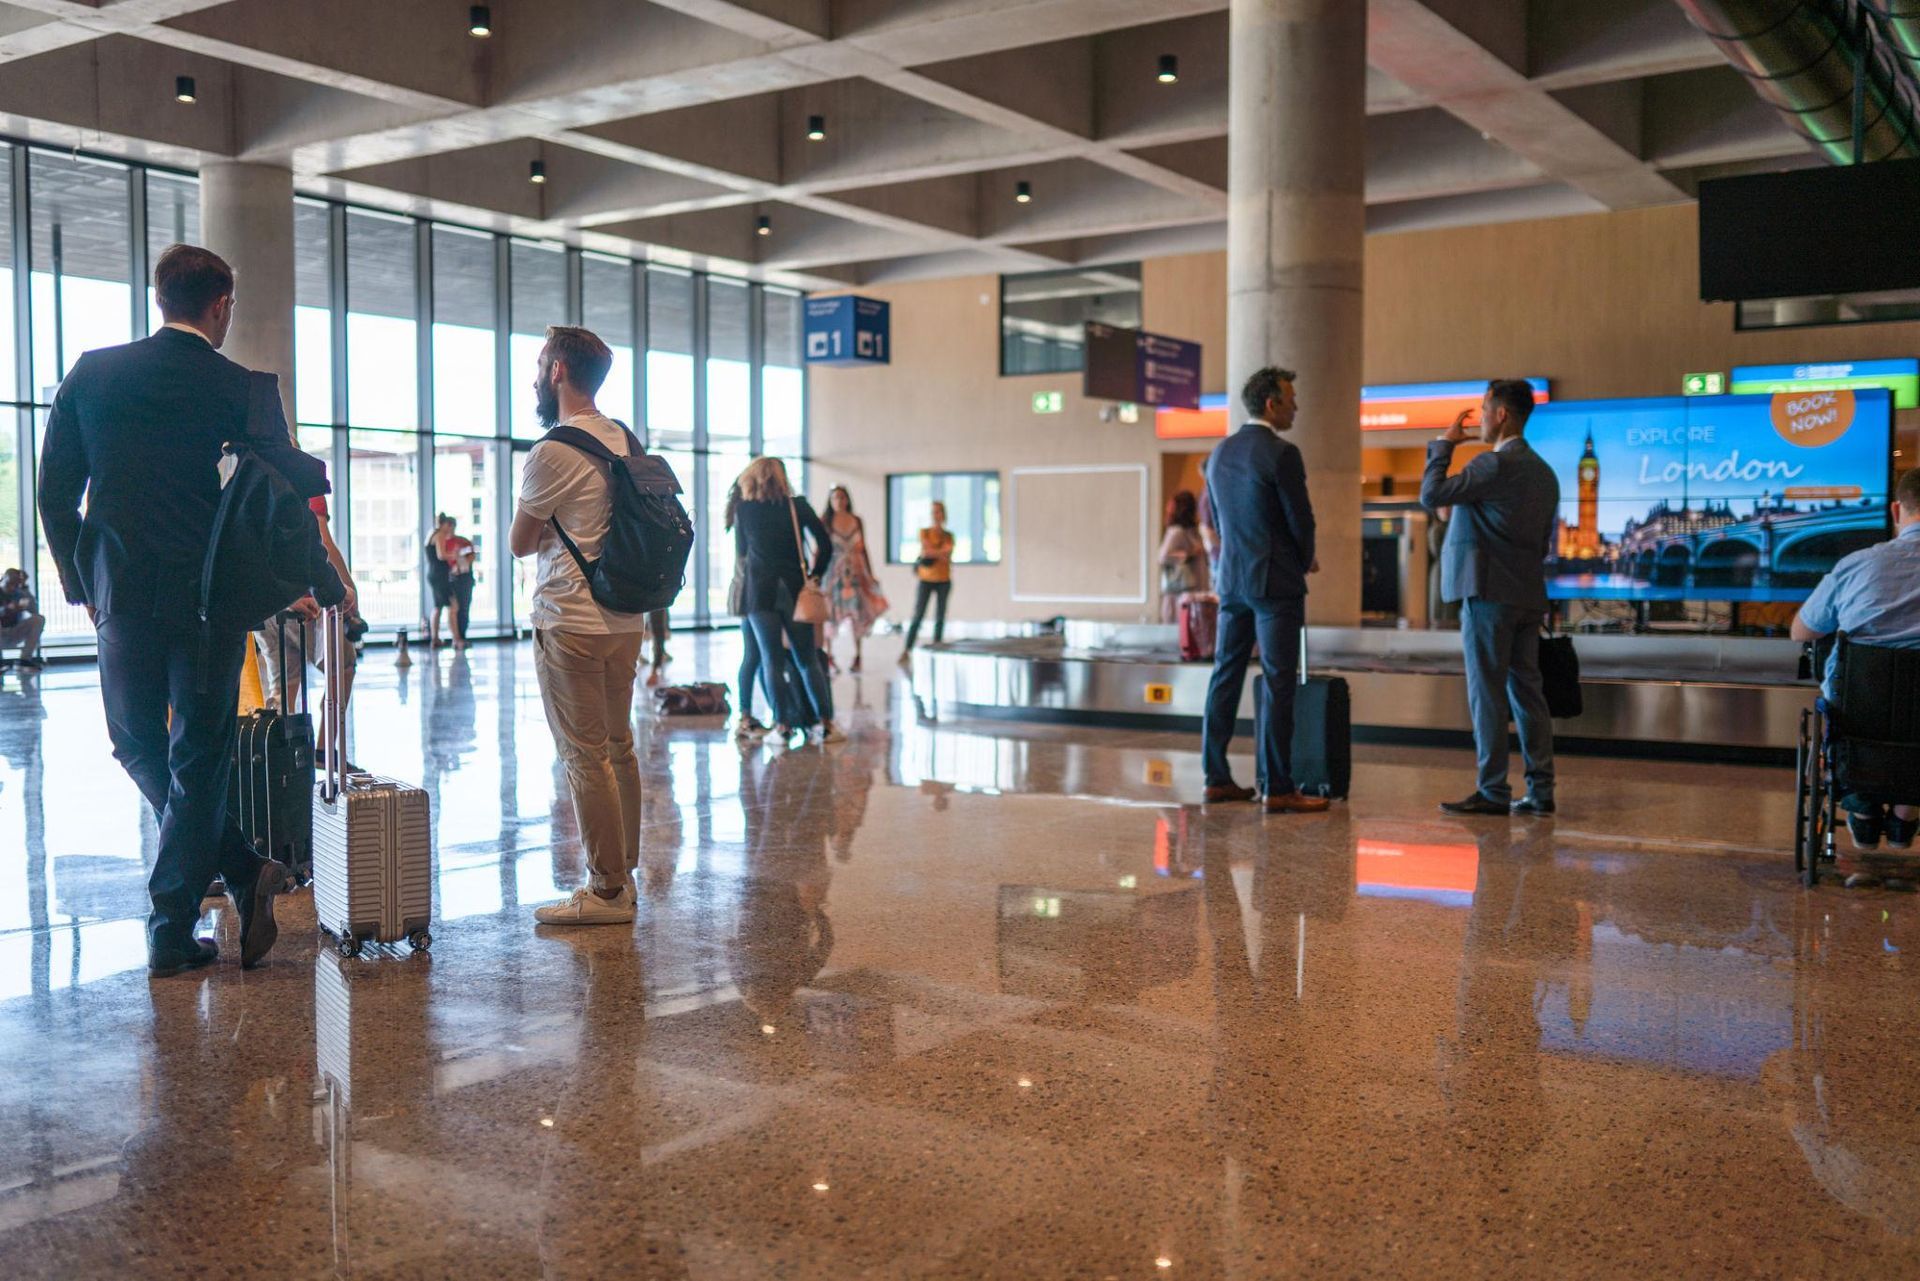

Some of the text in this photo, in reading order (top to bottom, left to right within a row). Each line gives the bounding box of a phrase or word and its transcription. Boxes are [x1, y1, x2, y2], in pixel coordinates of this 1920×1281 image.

[831, 330, 842, 356] 1
[875, 333, 883, 358] 1
[1785, 391, 1837, 417] BOOK
[1627, 426, 1716, 446] EXPLORE
[1637, 449, 1804, 485] London
